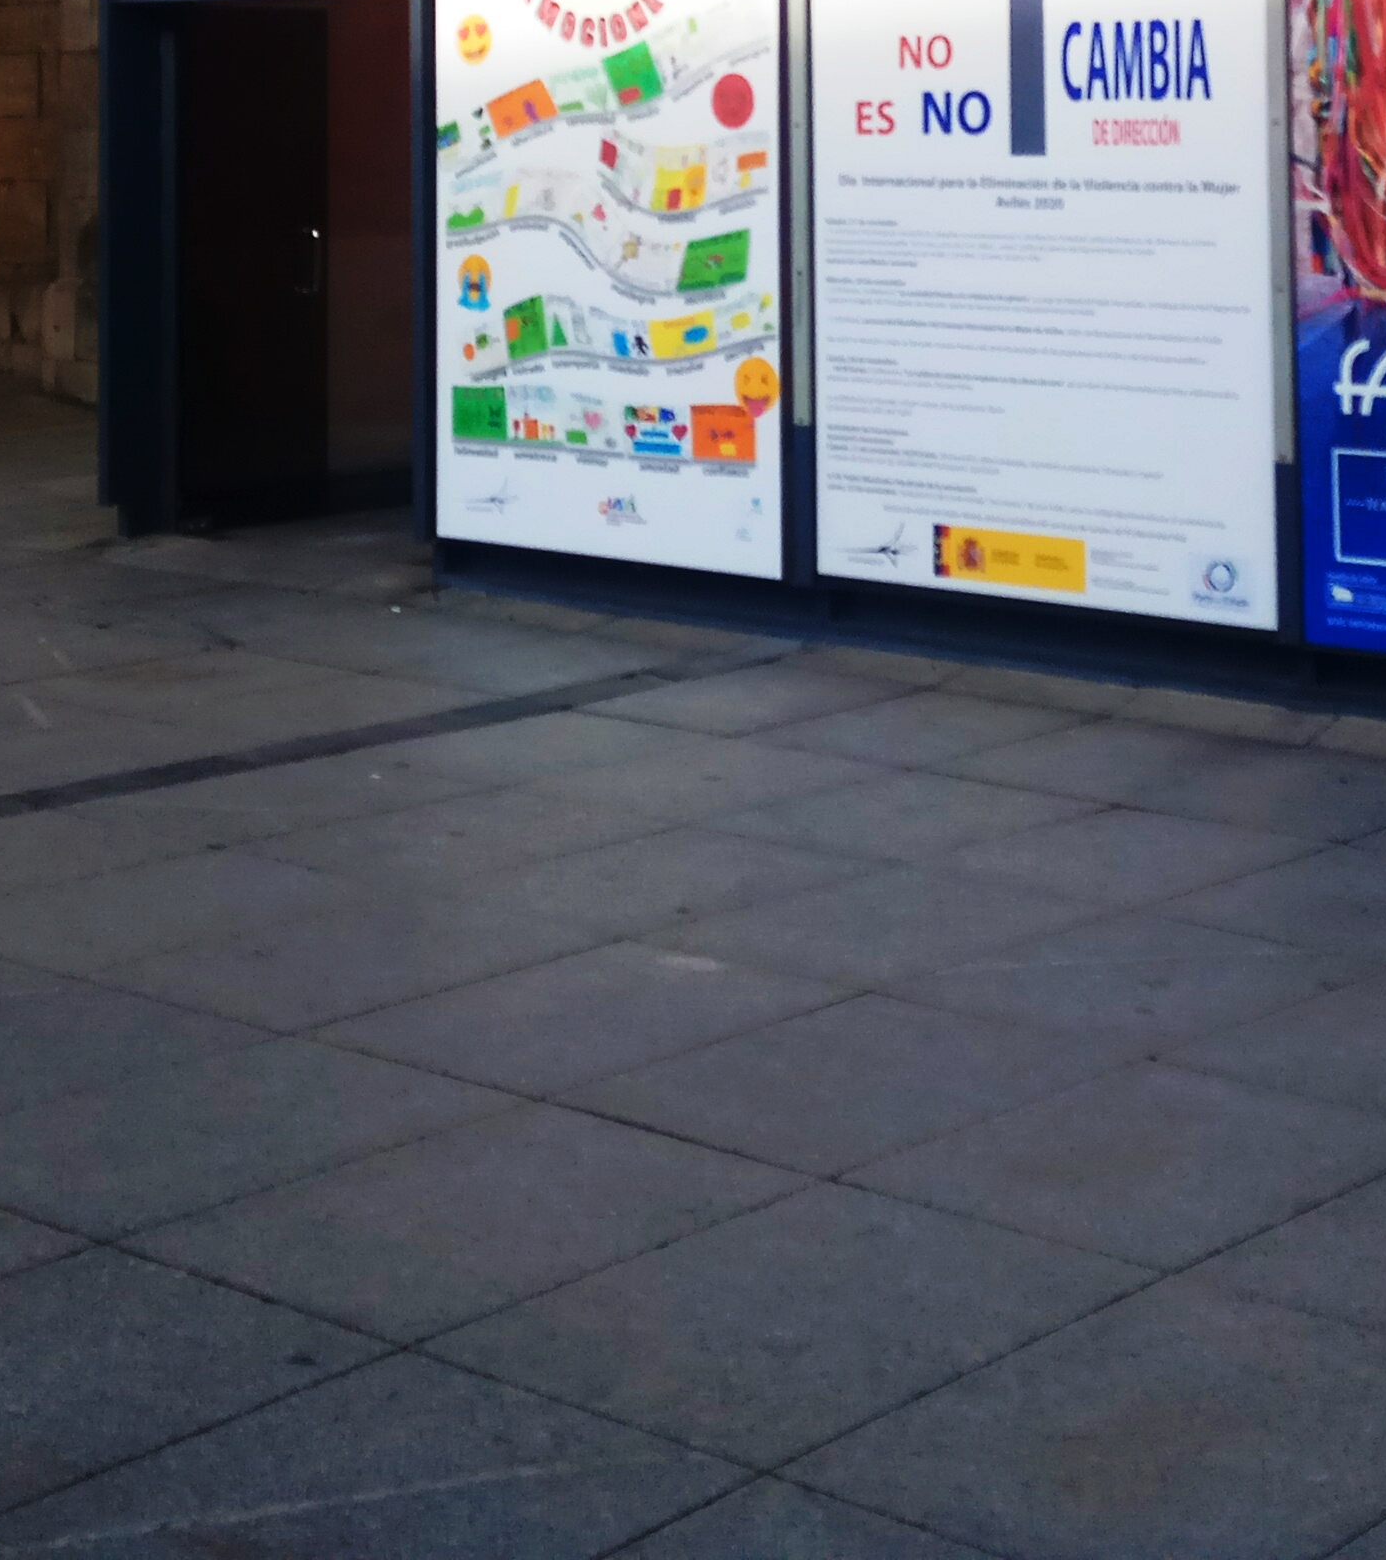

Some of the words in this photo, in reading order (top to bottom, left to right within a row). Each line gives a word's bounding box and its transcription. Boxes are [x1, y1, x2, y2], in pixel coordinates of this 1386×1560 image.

[898, 34, 953, 70] NO
[1060, 18, 1212, 101] CAMBIA
[855, 100, 896, 135] ES
[921, 90, 992, 136] NO
[1092, 120, 1110, 145] DE
[1112, 115, 1181, 146] DIRECCIÓN
